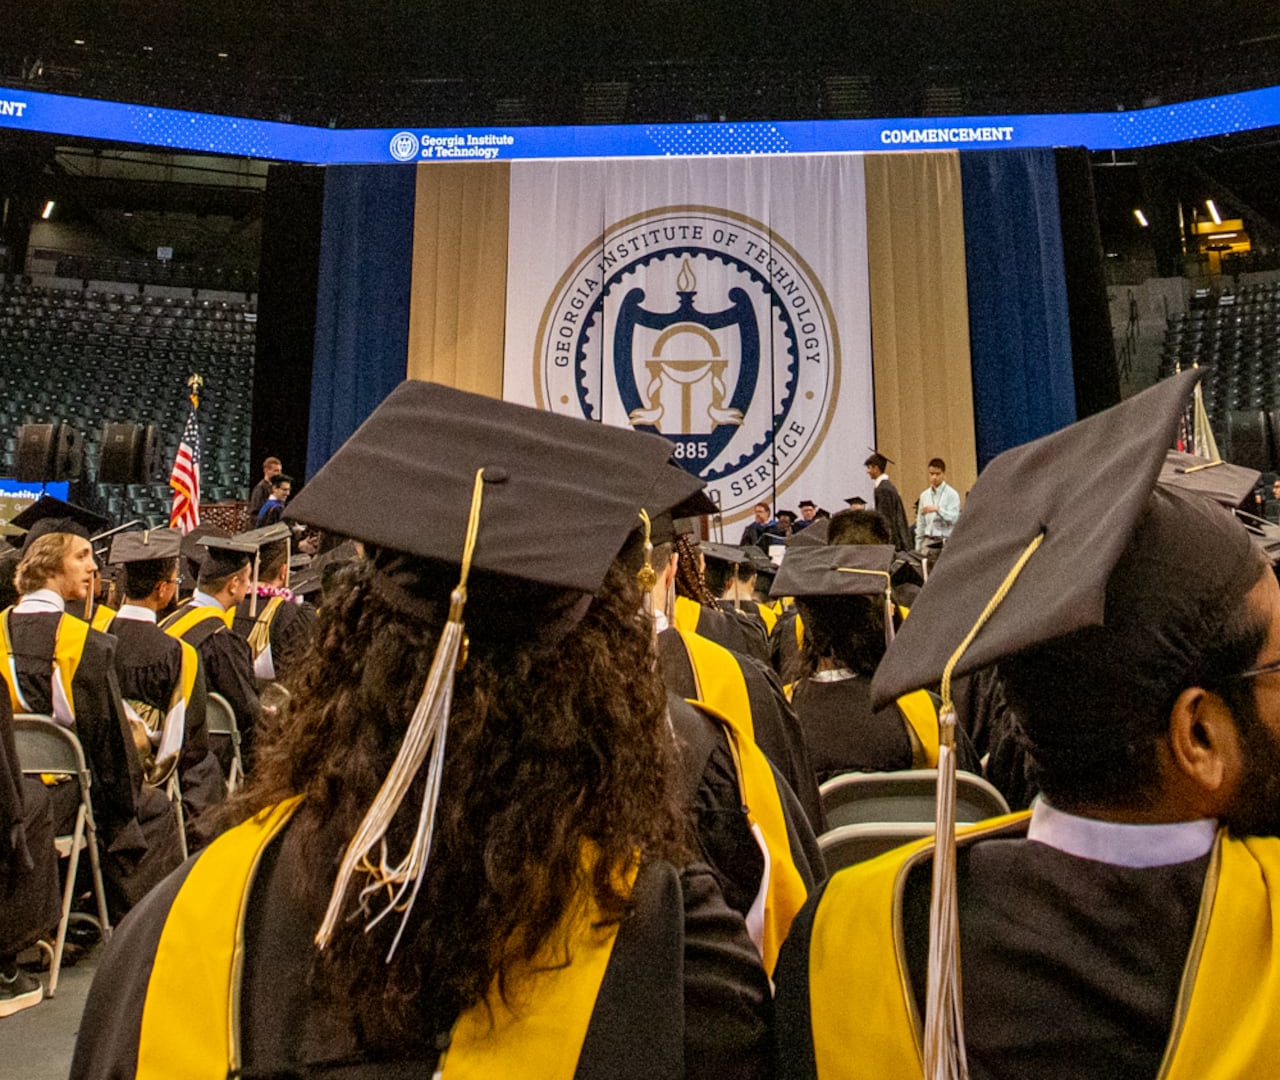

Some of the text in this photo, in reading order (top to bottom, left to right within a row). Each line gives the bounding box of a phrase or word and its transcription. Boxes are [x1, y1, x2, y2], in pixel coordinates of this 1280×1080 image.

[421, 134, 514, 147] Georgia Institute
[880, 126, 1013, 144] COMMENCEMENT
[421, 146, 499, 159] of Technology
[554, 224, 822, 368] GEORGIA INSTITUTE OF TECHNOLOGY
[673, 442, 708, 459] 885
[731, 420, 806, 497] SERVICE
